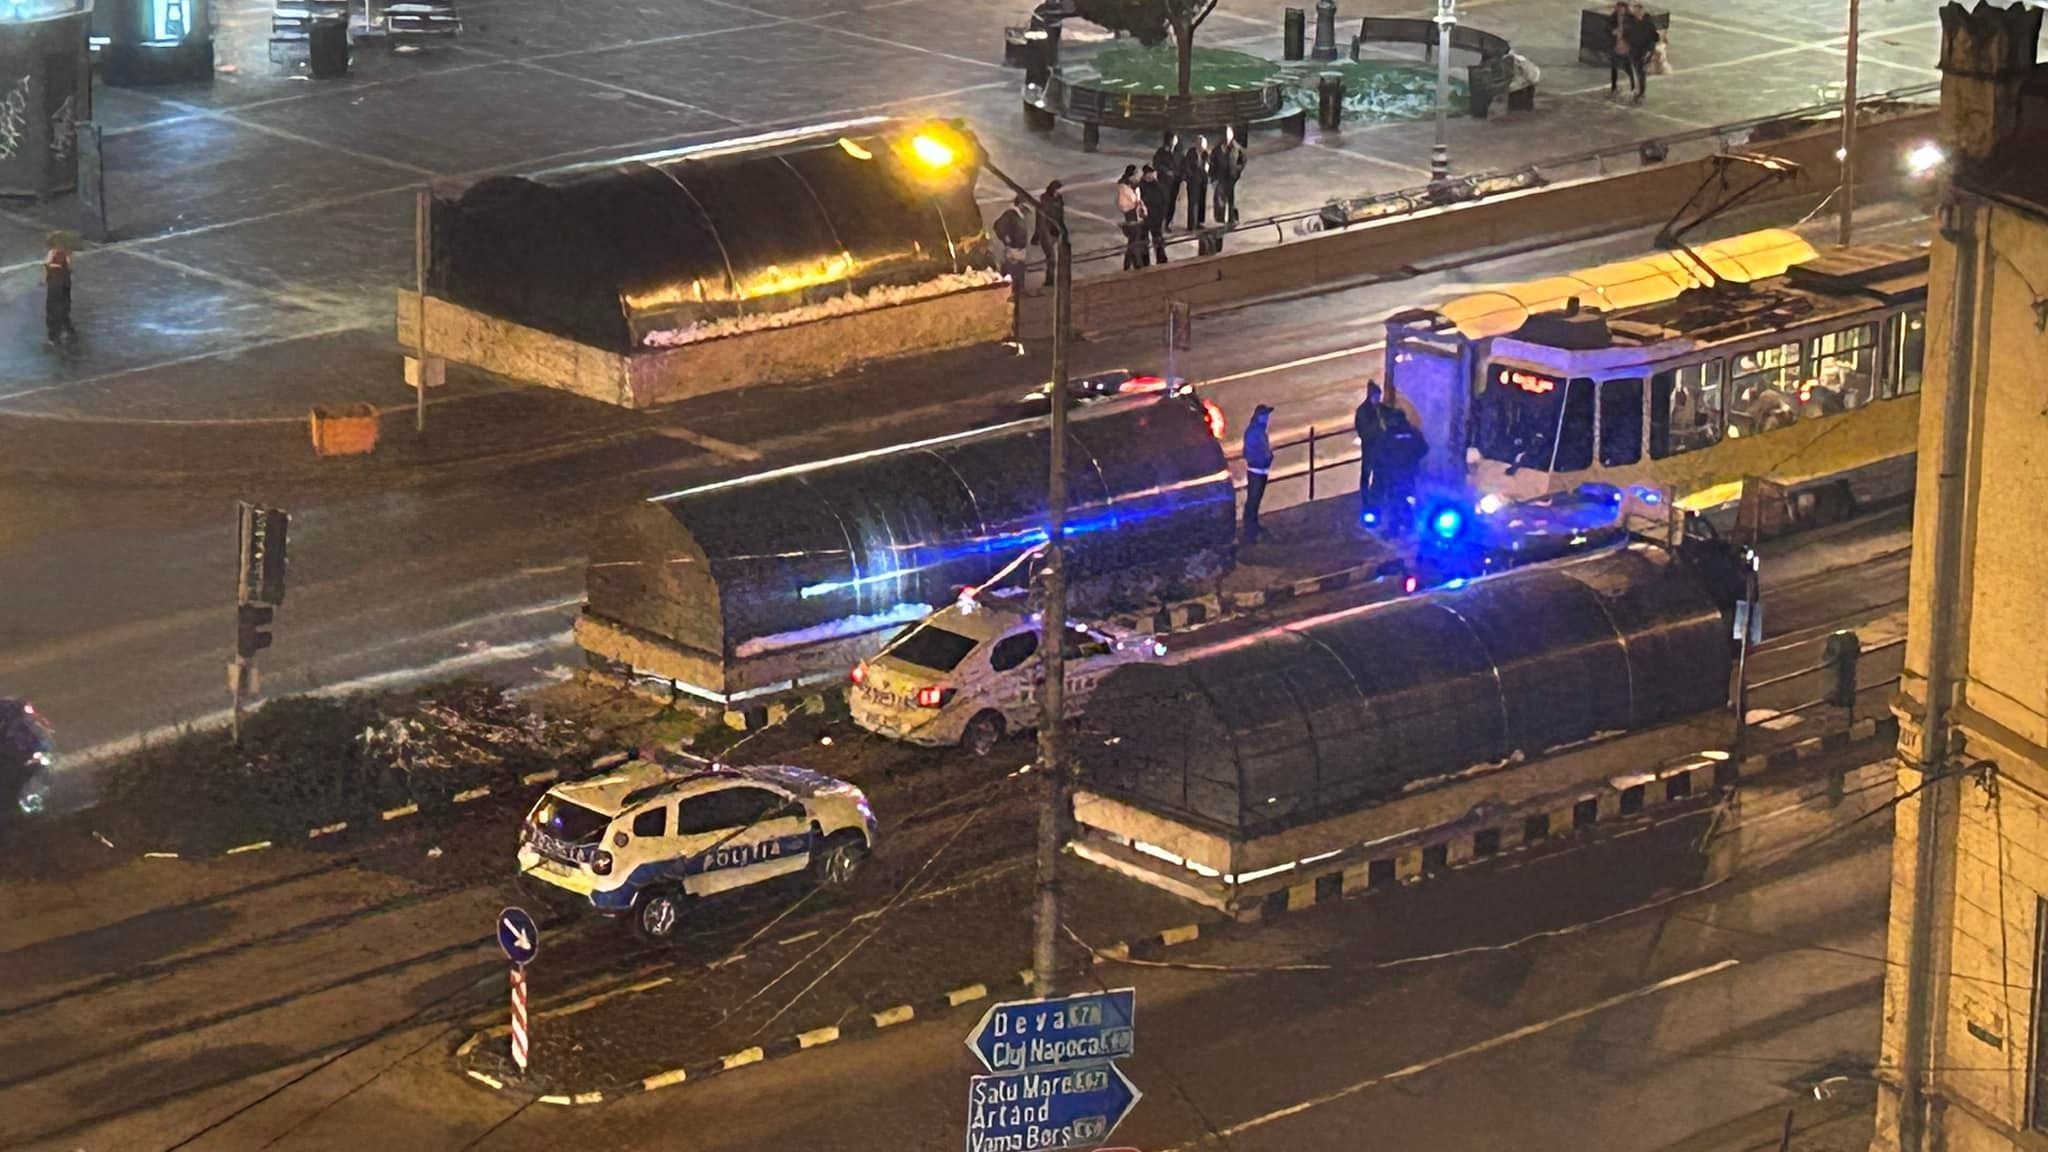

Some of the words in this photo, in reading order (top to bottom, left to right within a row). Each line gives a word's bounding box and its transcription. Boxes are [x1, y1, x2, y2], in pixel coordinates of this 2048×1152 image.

[993, 1041, 1026, 1071] Cluj
[1030, 1037, 1099, 1065] Napoca
[973, 1080, 1018, 1105] Satu
[1023, 1074, 1072, 1098] Mare
[971, 1131, 1023, 1152] Vama
